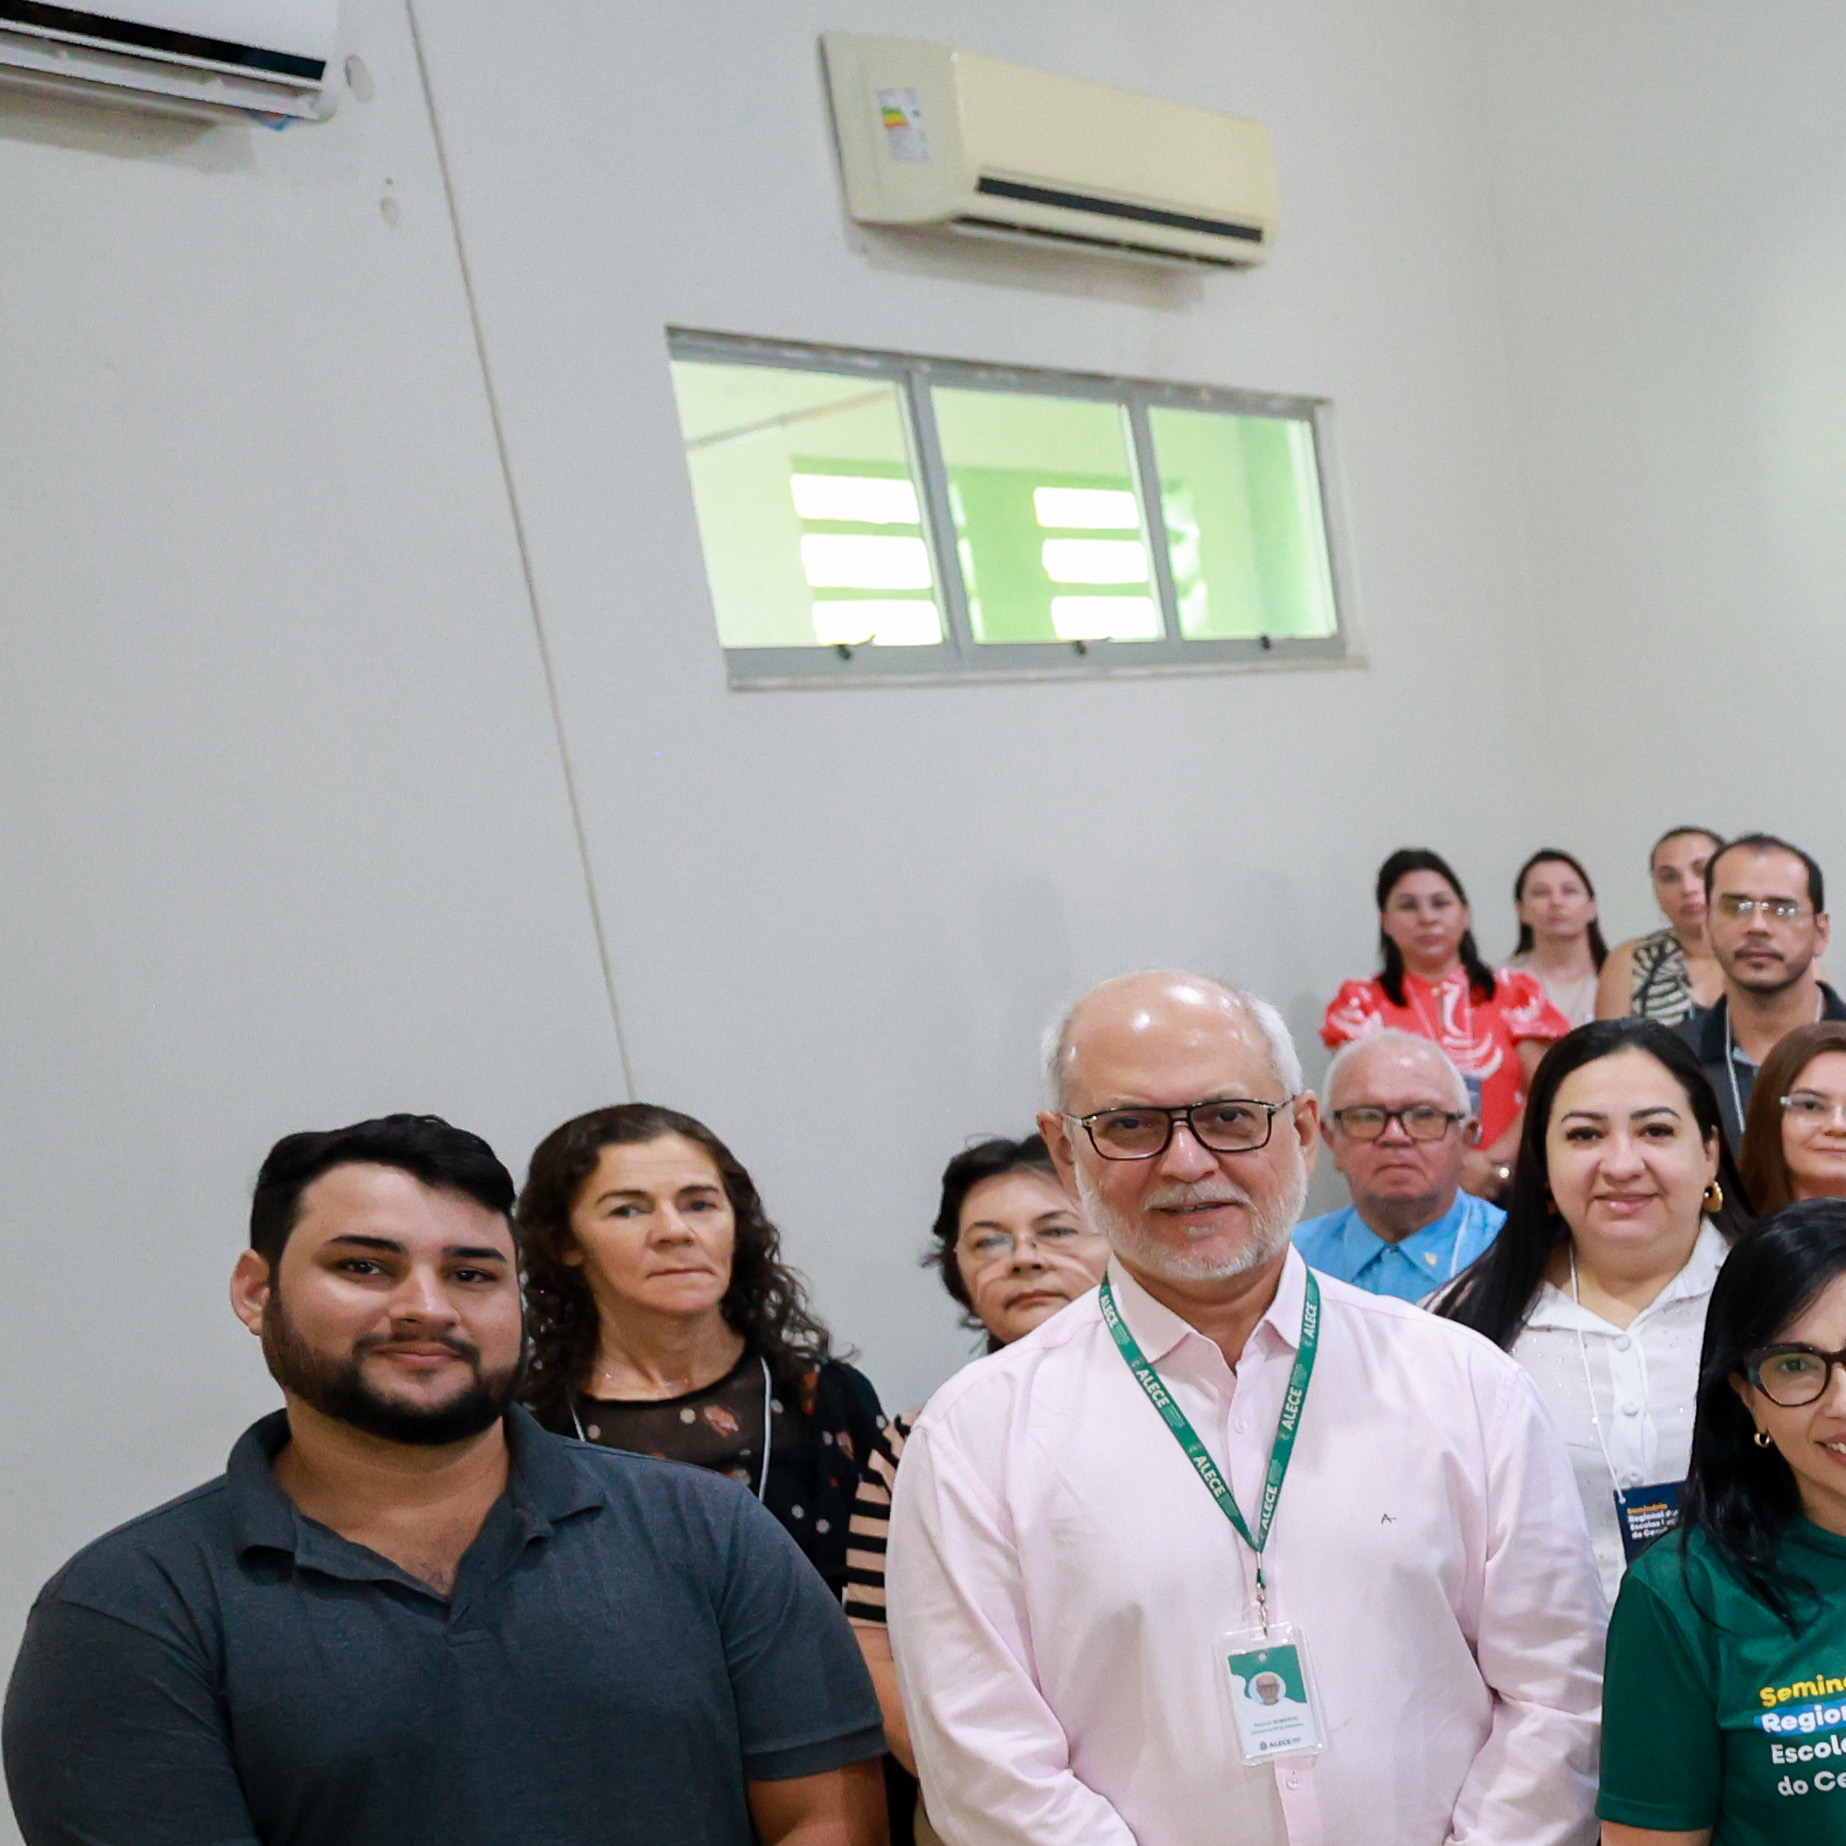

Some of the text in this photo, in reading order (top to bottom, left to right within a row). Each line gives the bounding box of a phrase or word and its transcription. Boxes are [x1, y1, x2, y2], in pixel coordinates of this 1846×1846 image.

[1304, 1301, 1318, 1338] ALECE
[1136, 1368, 1170, 1409] ALECE
[1285, 1385, 1303, 1431] ALECE
[1192, 1455, 1226, 1498] ALECE
[1261, 1484, 1278, 1531] ALECE
[1777, 1776, 1809, 1796] do
